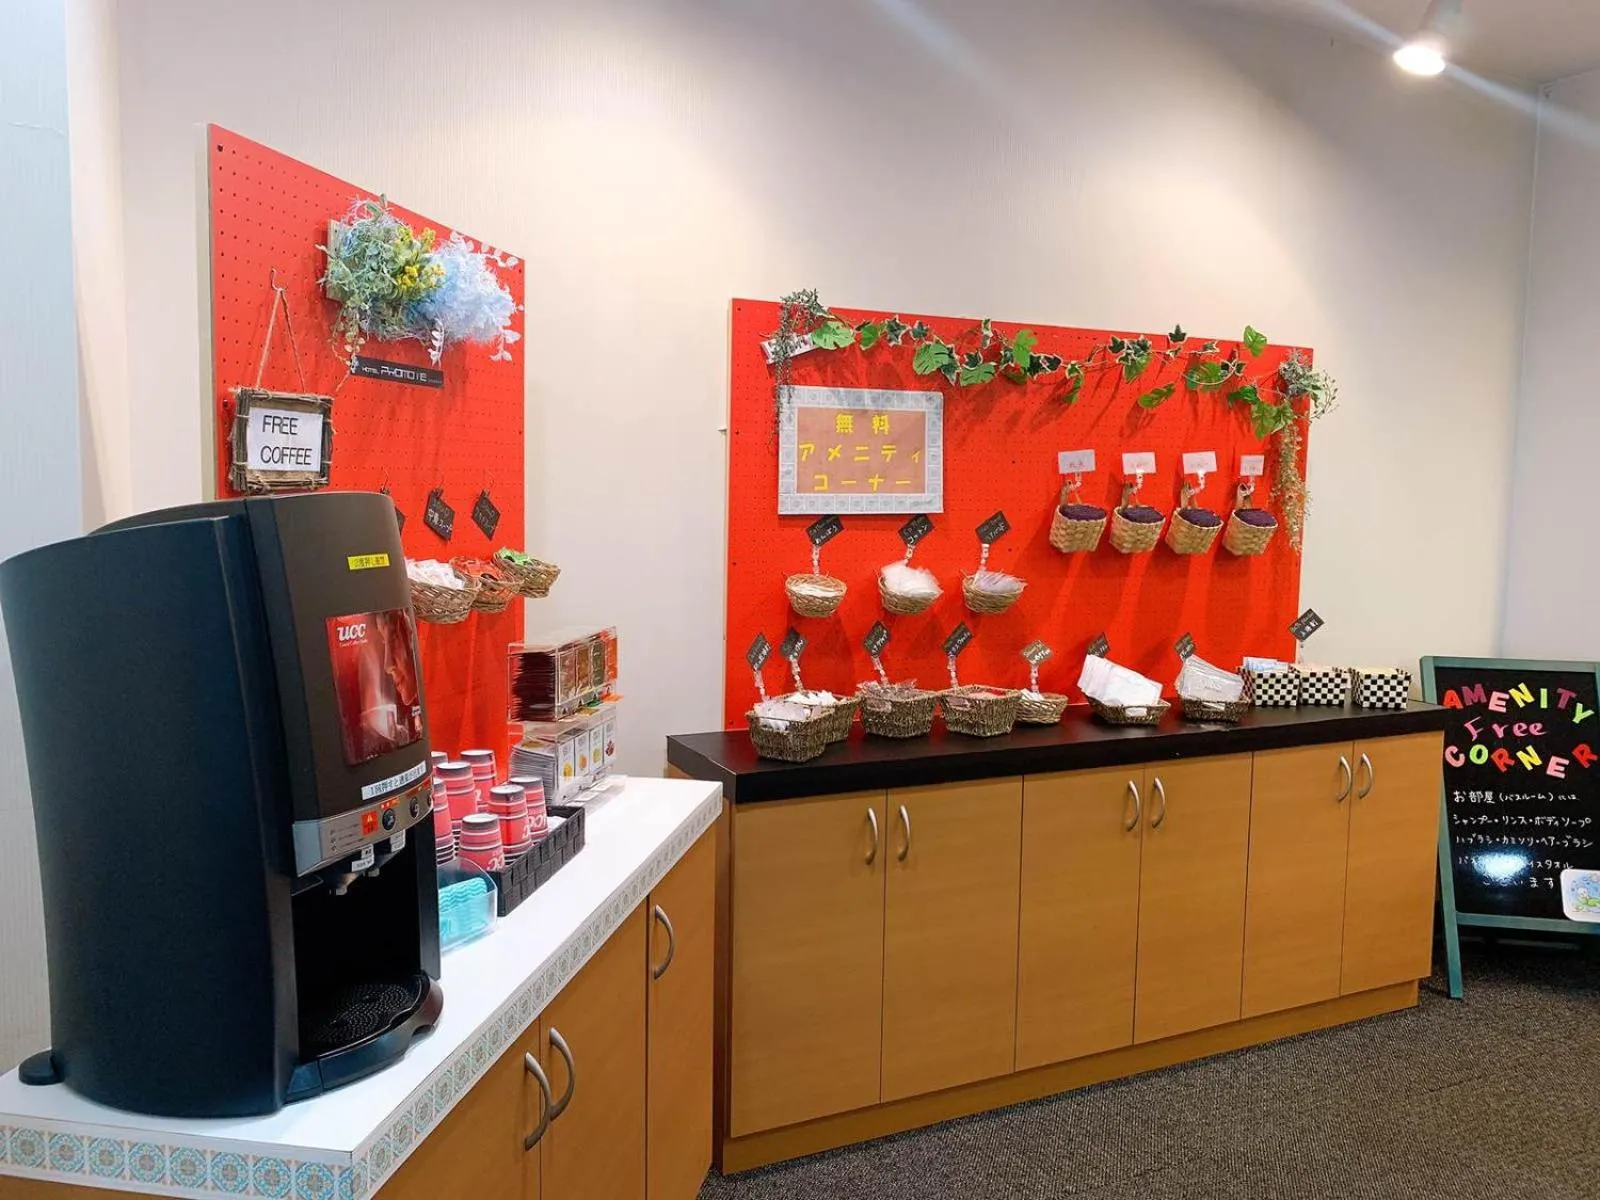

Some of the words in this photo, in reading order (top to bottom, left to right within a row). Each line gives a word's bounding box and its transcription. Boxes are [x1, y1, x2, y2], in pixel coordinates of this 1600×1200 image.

[262, 415, 299, 436] FREE
[835, 413, 890, 435] 無料
[260, 445, 313, 466] COFFEE
[799, 443, 921, 463] アメニティ
[814, 474, 911, 491] コーナー
[1443, 682, 1595, 724] AMENITY
[1464, 716, 1549, 741] Free
[1445, 743, 1598, 779] CORNER
